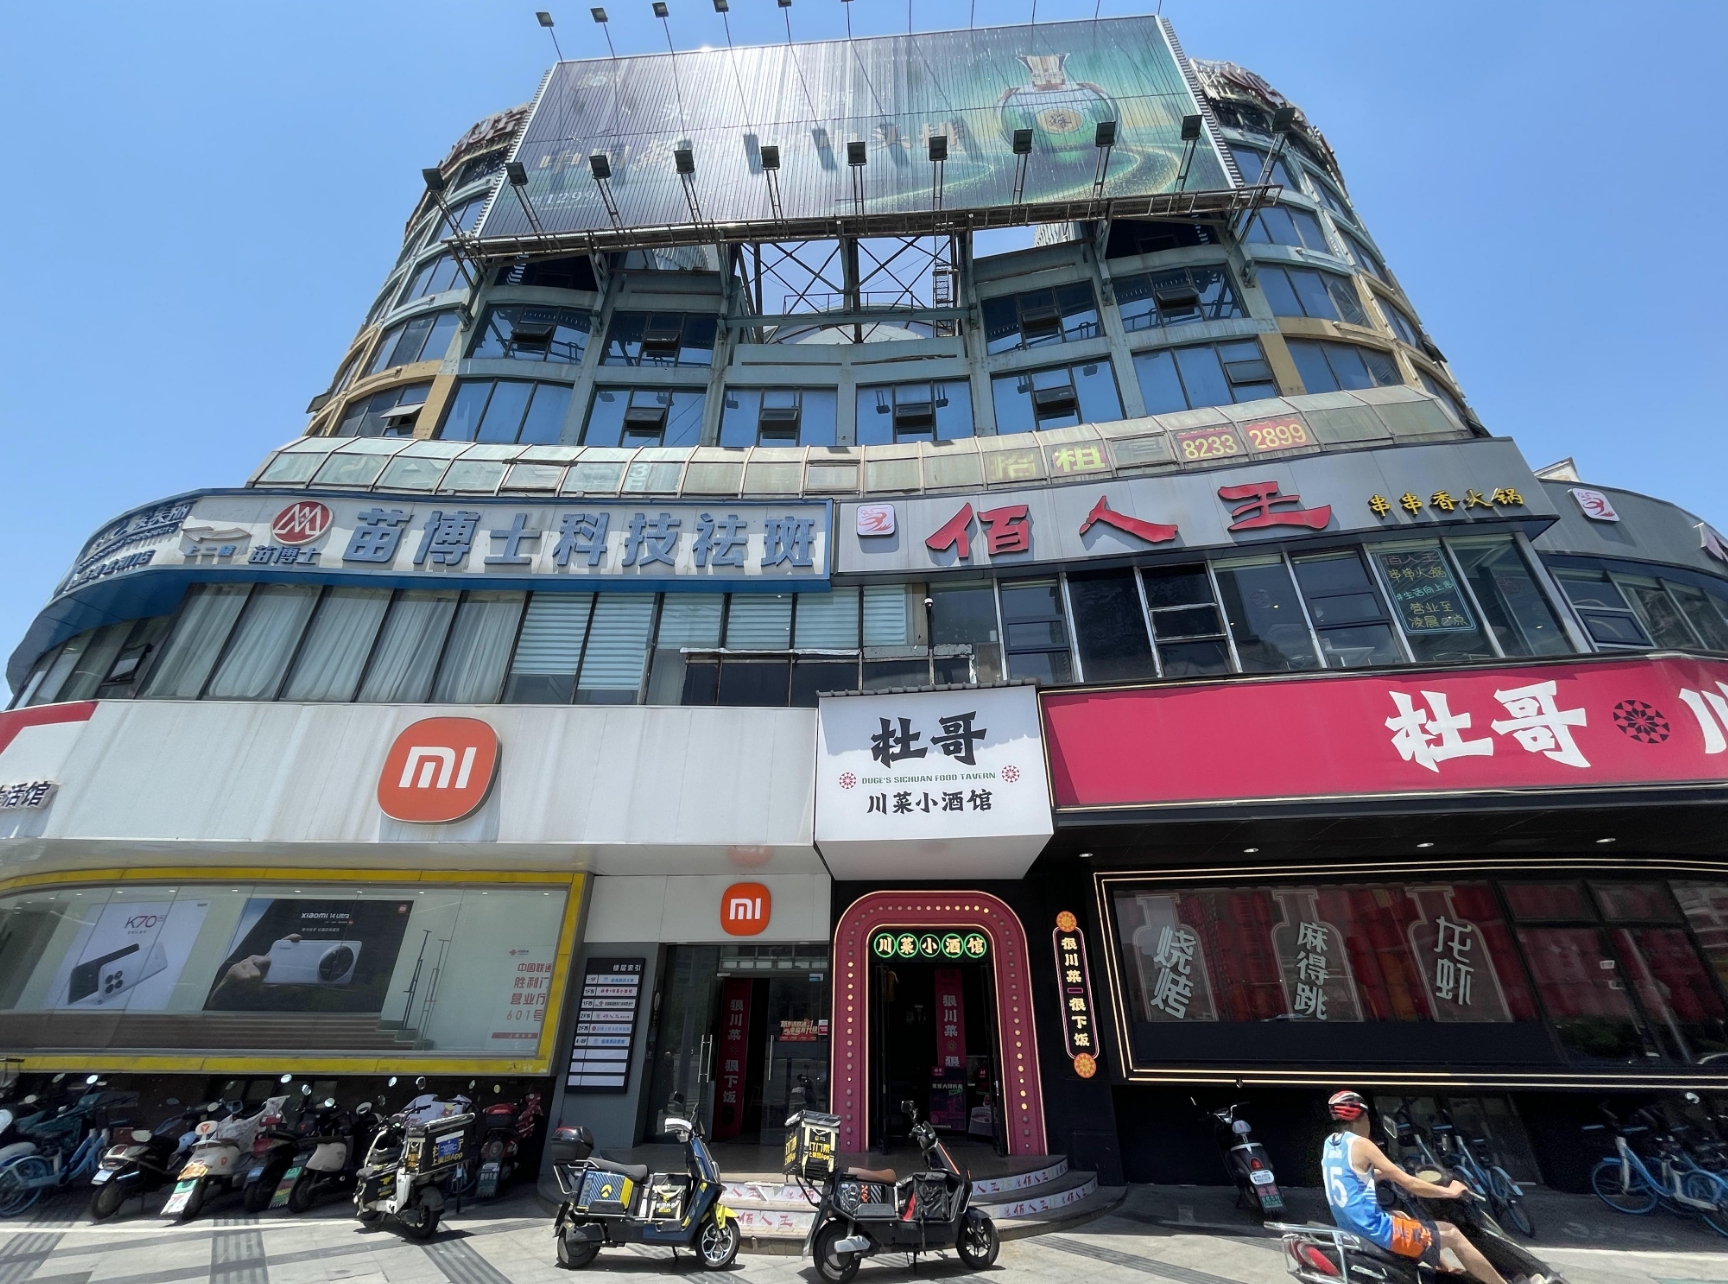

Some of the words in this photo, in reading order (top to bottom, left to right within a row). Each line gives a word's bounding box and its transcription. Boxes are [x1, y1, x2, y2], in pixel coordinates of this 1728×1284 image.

[1182, 434, 1238, 459] 8233
[1249, 423, 1307, 449] 2899
[1368, 487, 1524, 519] 串串香火锅
[926, 480, 1331, 559] 佰人王
[342, 508, 815, 569] 苗博士科技祛斑
[248, 545, 322, 565] 苗博士
[1382, 551, 1441, 566] 佰人王
[1388, 566, 1447, 582] 串串火锅
[1410, 600, 1454, 615] 营业至
[1384, 680, 1592, 774] 杜哥
[870, 711, 988, 769] 杜哥
[861, 777, 892, 785] DUGE'S
[893, 775, 933, 783] SICHUAN
[934, 774, 958, 782] FOOD
[959, 771, 996, 781] TAVERN
[866, 789, 994, 815] 川菜小酒馆
[124, 915, 158, 929] K70
[878, 936, 984, 955] 川菜小酒馆
[517, 962, 552, 973] 中国联通
[1151, 926, 1197, 1019] 烧烤
[1294, 922, 1329, 1020] 麻得跳
[510, 992, 547, 1005] 营业厅
[1013, 1198, 1049, 1216] 佰人王
[738, 1211, 794, 1228] 佰人王
